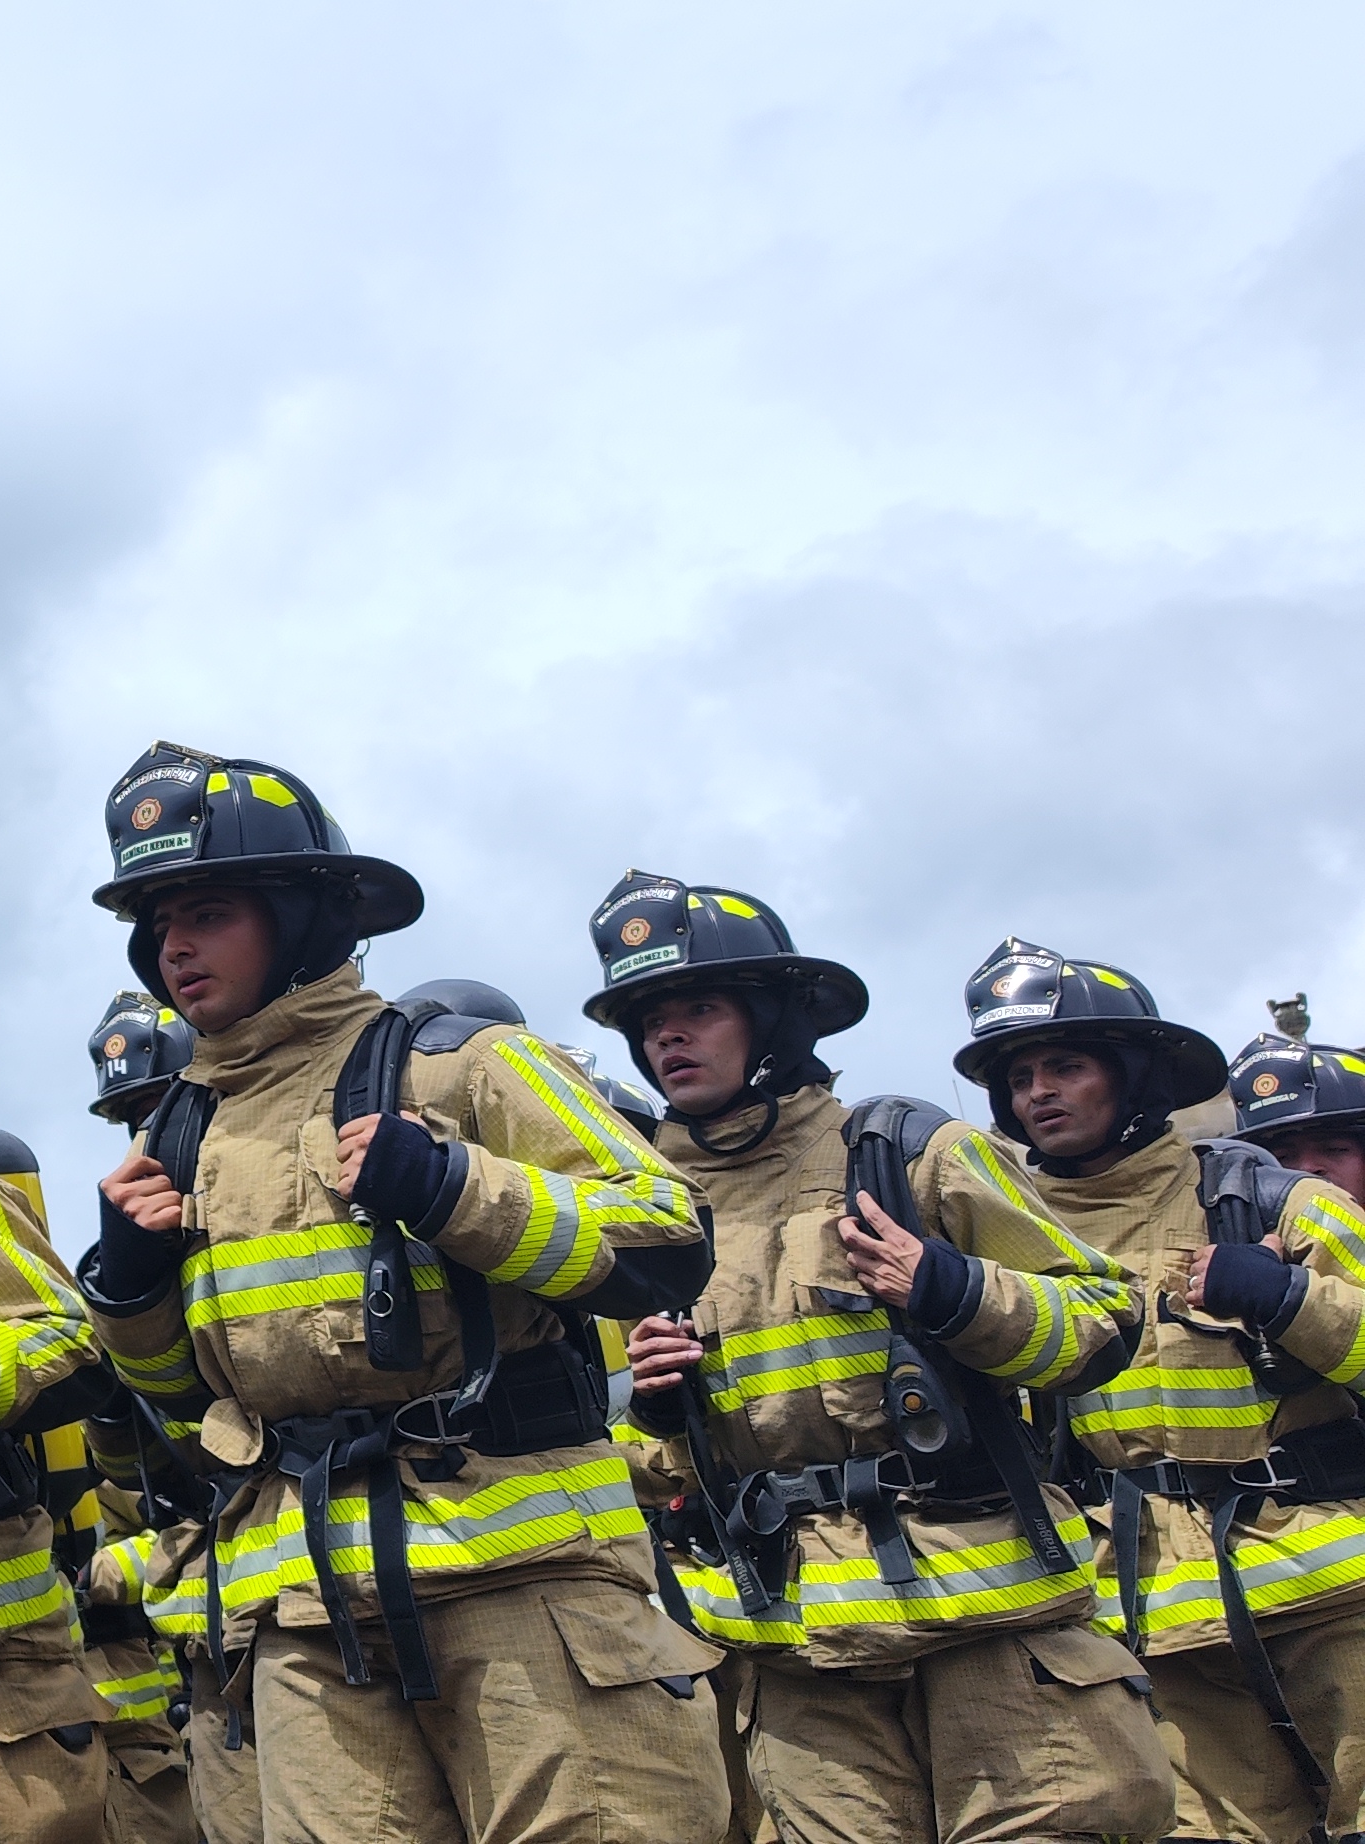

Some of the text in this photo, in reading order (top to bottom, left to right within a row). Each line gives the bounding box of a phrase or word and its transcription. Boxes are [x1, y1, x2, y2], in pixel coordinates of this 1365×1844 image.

[150, 837, 176, 852] KEVIN
[176, 836, 190, 847] A+
[106, 1058, 128, 1079] 14
[1033, 1517, 1062, 1560] Dräger
[731, 1555, 754, 1597] Dräger
